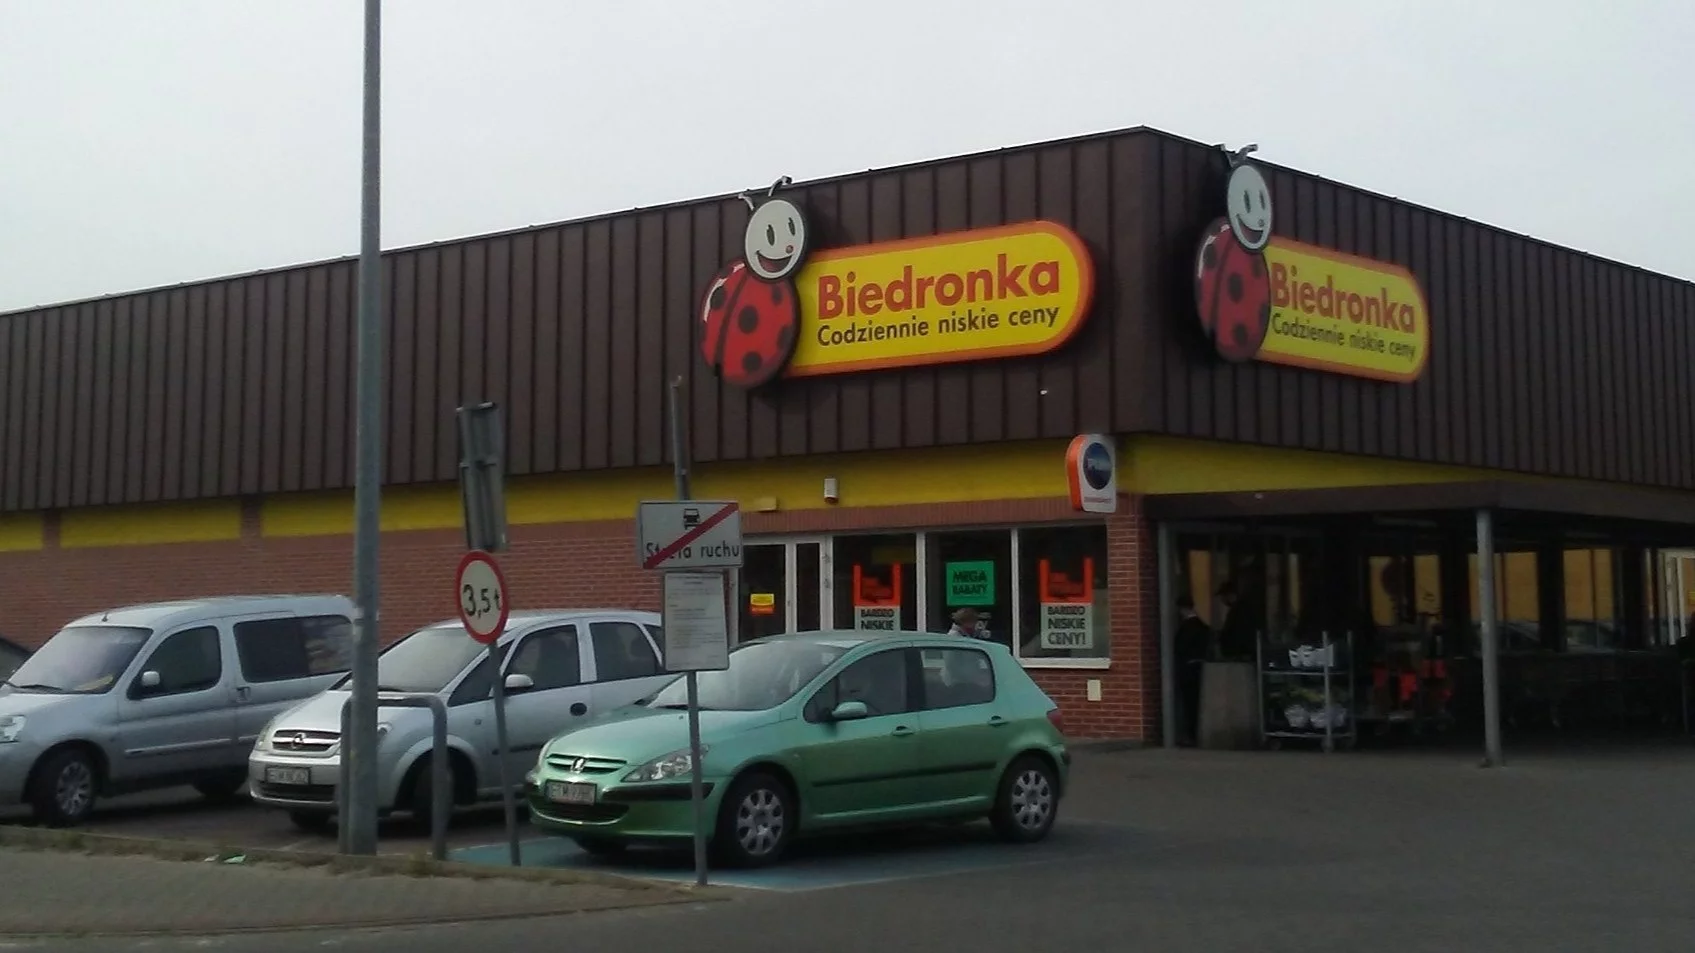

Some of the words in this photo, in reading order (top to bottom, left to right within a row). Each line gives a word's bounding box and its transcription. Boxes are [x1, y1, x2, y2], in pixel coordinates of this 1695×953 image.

[818, 253, 1060, 320] Biedronka
[1271, 262, 1415, 334] Biedronka
[818, 315, 929, 347] Codziennie
[938, 307, 999, 334] niskie
[1008, 307, 1060, 328] ceny
[1272, 312, 1345, 346] Codziennie
[1349, 328, 1385, 353] niskie
[1389, 341, 1416, 362] ceny
[701, 540, 740, 558] ruchu
[953, 570, 987, 583] MEGA
[1048, 605, 1086, 616] BARDZO
[861, 619, 894, 631] NISKIE
[1048, 617, 1086, 629] NISKIE
[1048, 631, 1086, 645] CENY!
